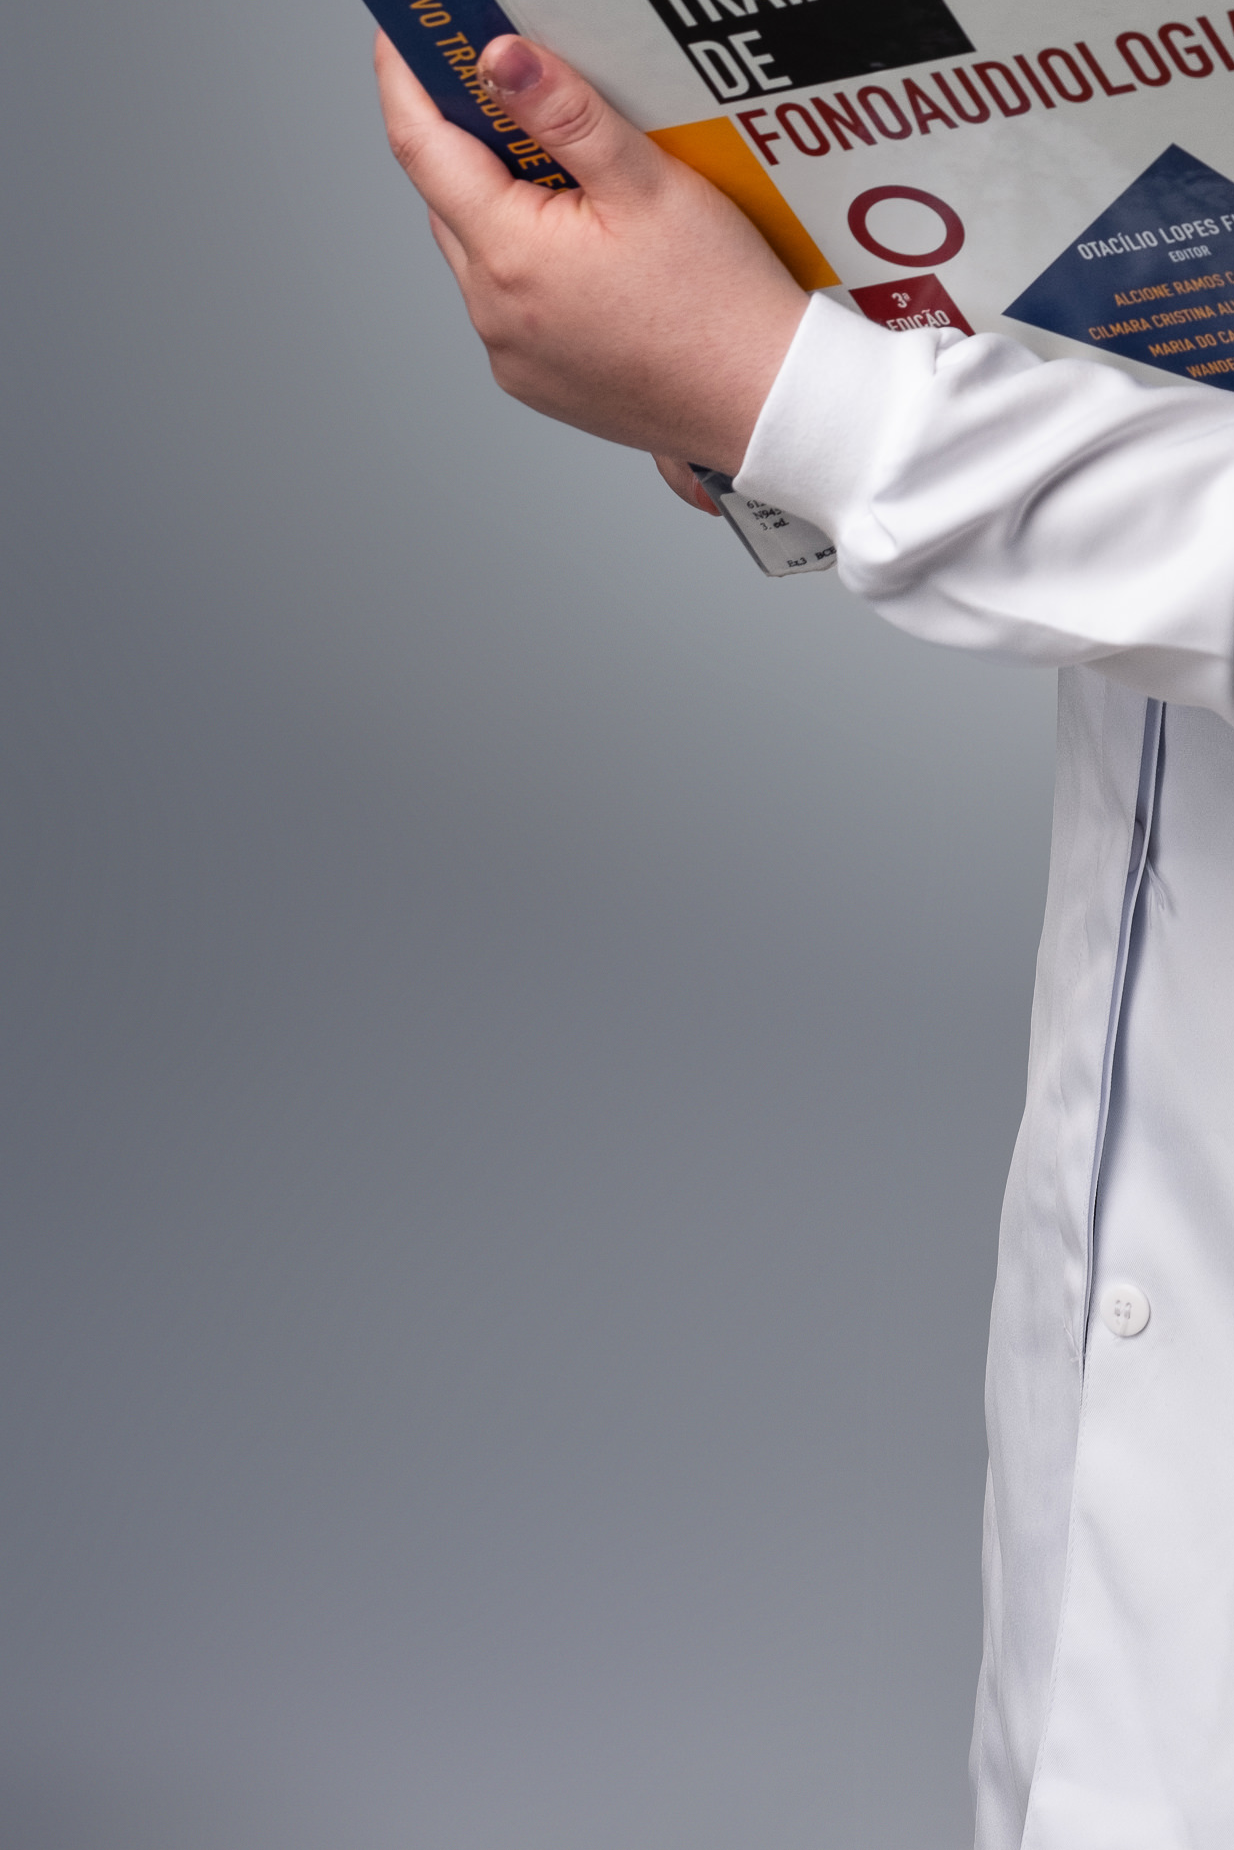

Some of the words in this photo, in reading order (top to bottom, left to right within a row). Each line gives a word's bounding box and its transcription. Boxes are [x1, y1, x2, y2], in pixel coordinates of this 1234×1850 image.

[687, 30, 792, 99] DE
[507, 138, 552, 170] DE
[1077, 230, 1158, 260] OTACÍLIO
[1158, 218, 1220, 244] LOPES
[1168, 245, 1212, 262] EDITOR
[1114, 283, 1174, 307] ALCIONE
[1172, 273, 1225, 295] RAMOS
[1088, 318, 1152, 341] CILMARA
[1151, 305, 1217, 328] CRISTINA
[1148, 338, 1197, 357] MARIA
[1195, 333, 1218, 349] DO
